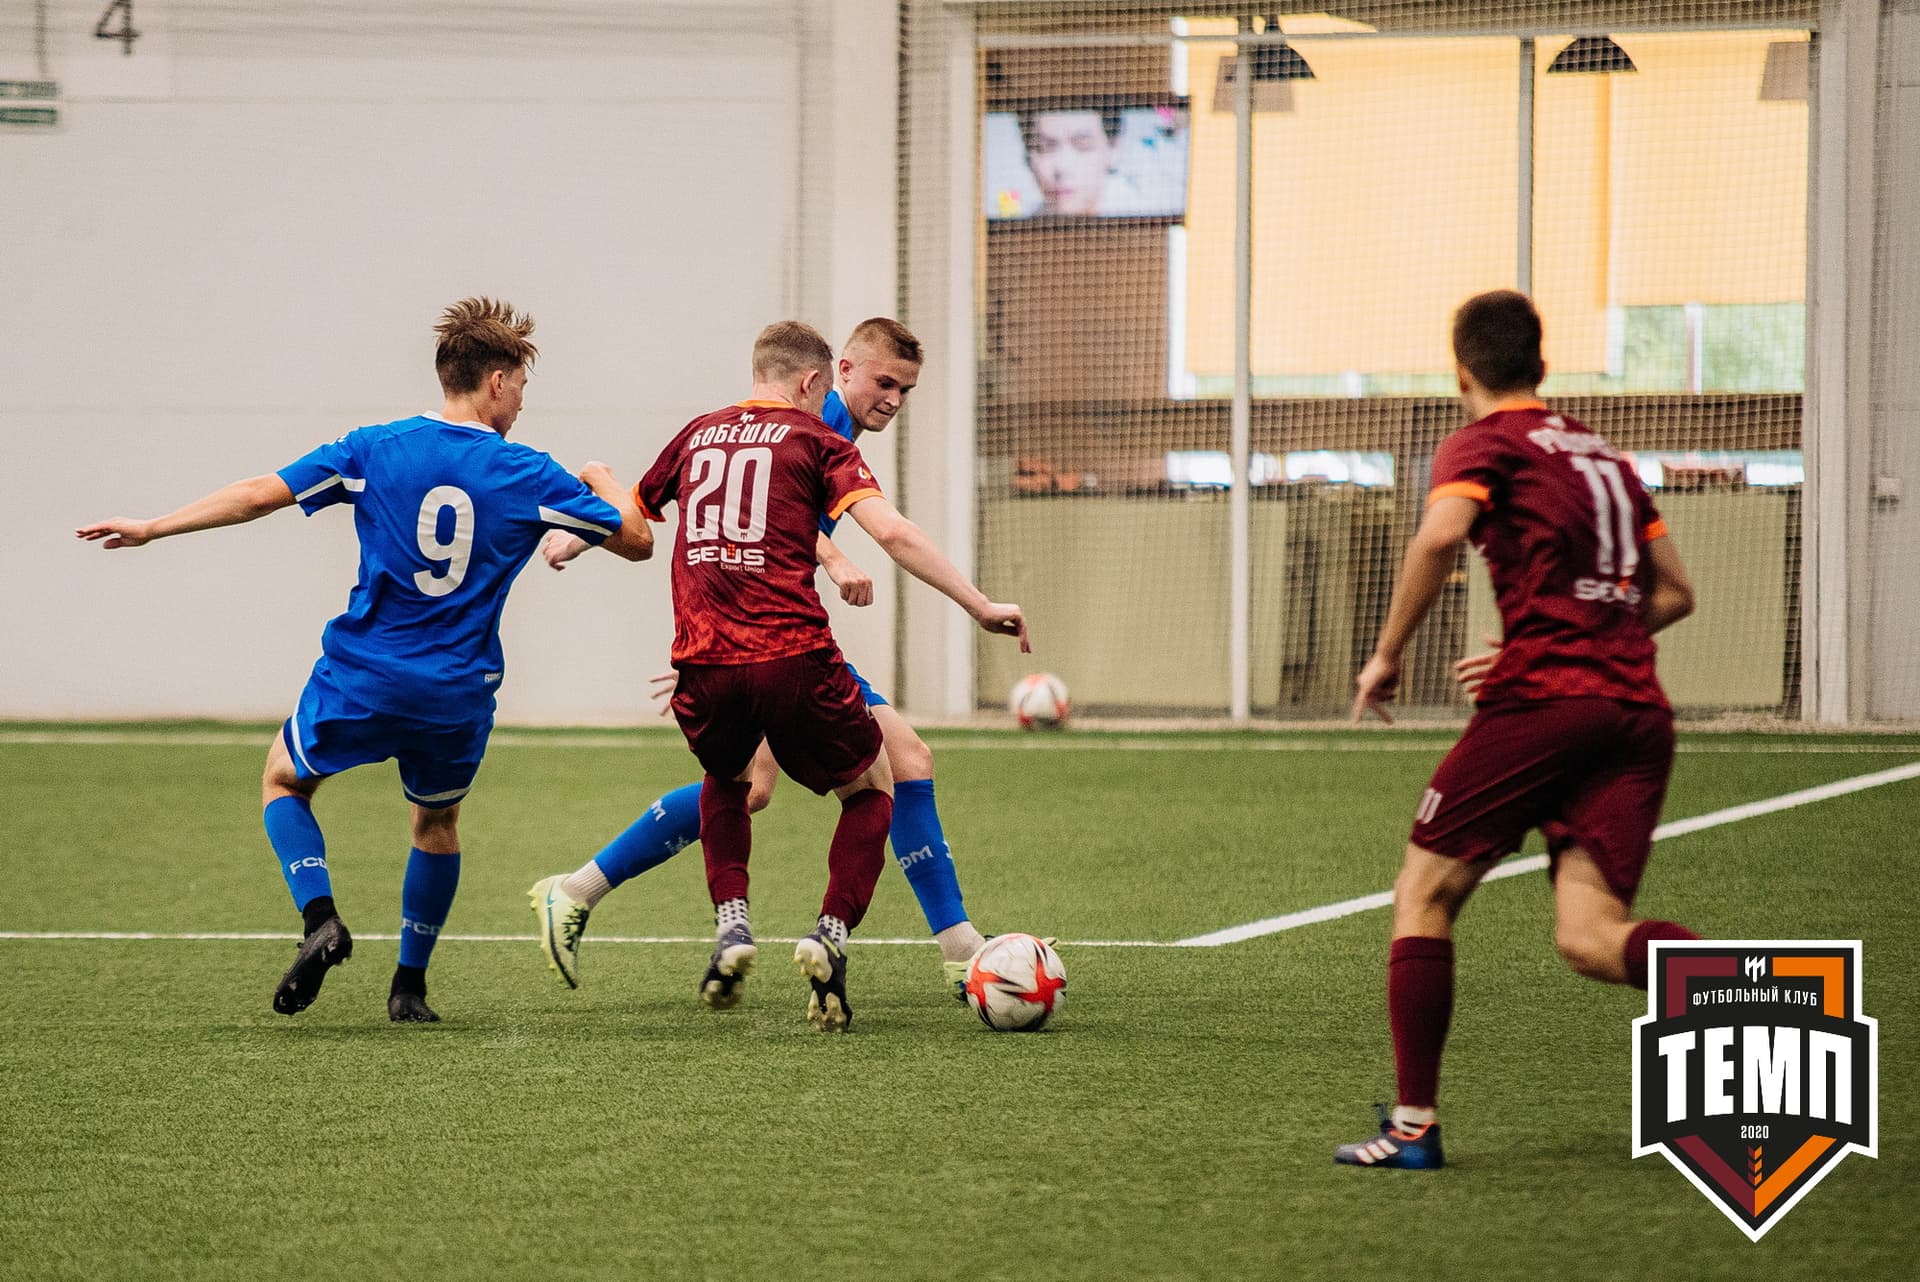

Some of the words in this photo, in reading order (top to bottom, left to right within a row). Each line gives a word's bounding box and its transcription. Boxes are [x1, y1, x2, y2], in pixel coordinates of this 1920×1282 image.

[95, 0, 141, 56] 4
[689, 422, 792, 450] БОБЕШКО
[686, 447, 773, 544] 20
[1570, 456, 1640, 577] 11
[413, 485, 476, 598] 9
[687, 544, 766, 567] SEUS
[744, 565, 766, 574] Union
